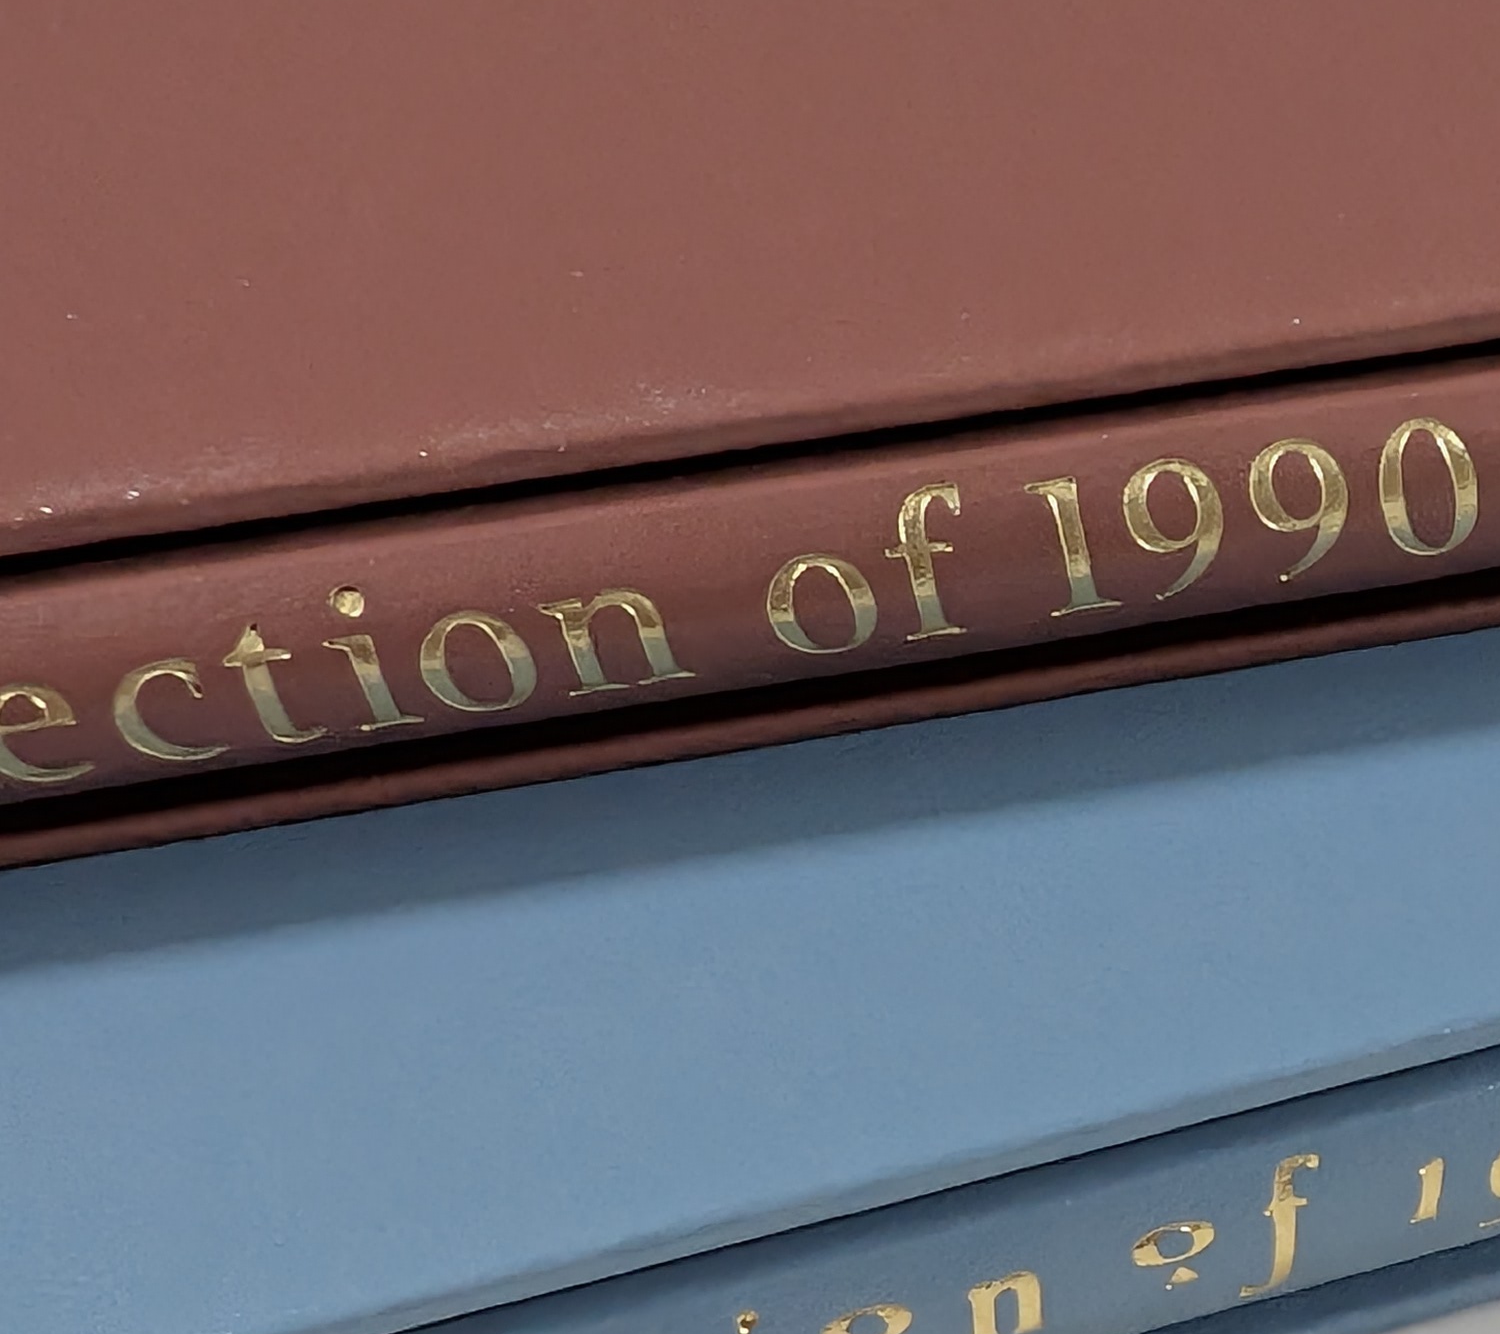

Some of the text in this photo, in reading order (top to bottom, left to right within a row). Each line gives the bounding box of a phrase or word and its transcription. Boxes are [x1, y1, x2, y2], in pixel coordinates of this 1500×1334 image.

[0, 584, 696, 783] ection
[766, 482, 967, 655] of
[1023, 417, 1479, 617] 1990
[1131, 1153, 1321, 1297] of
